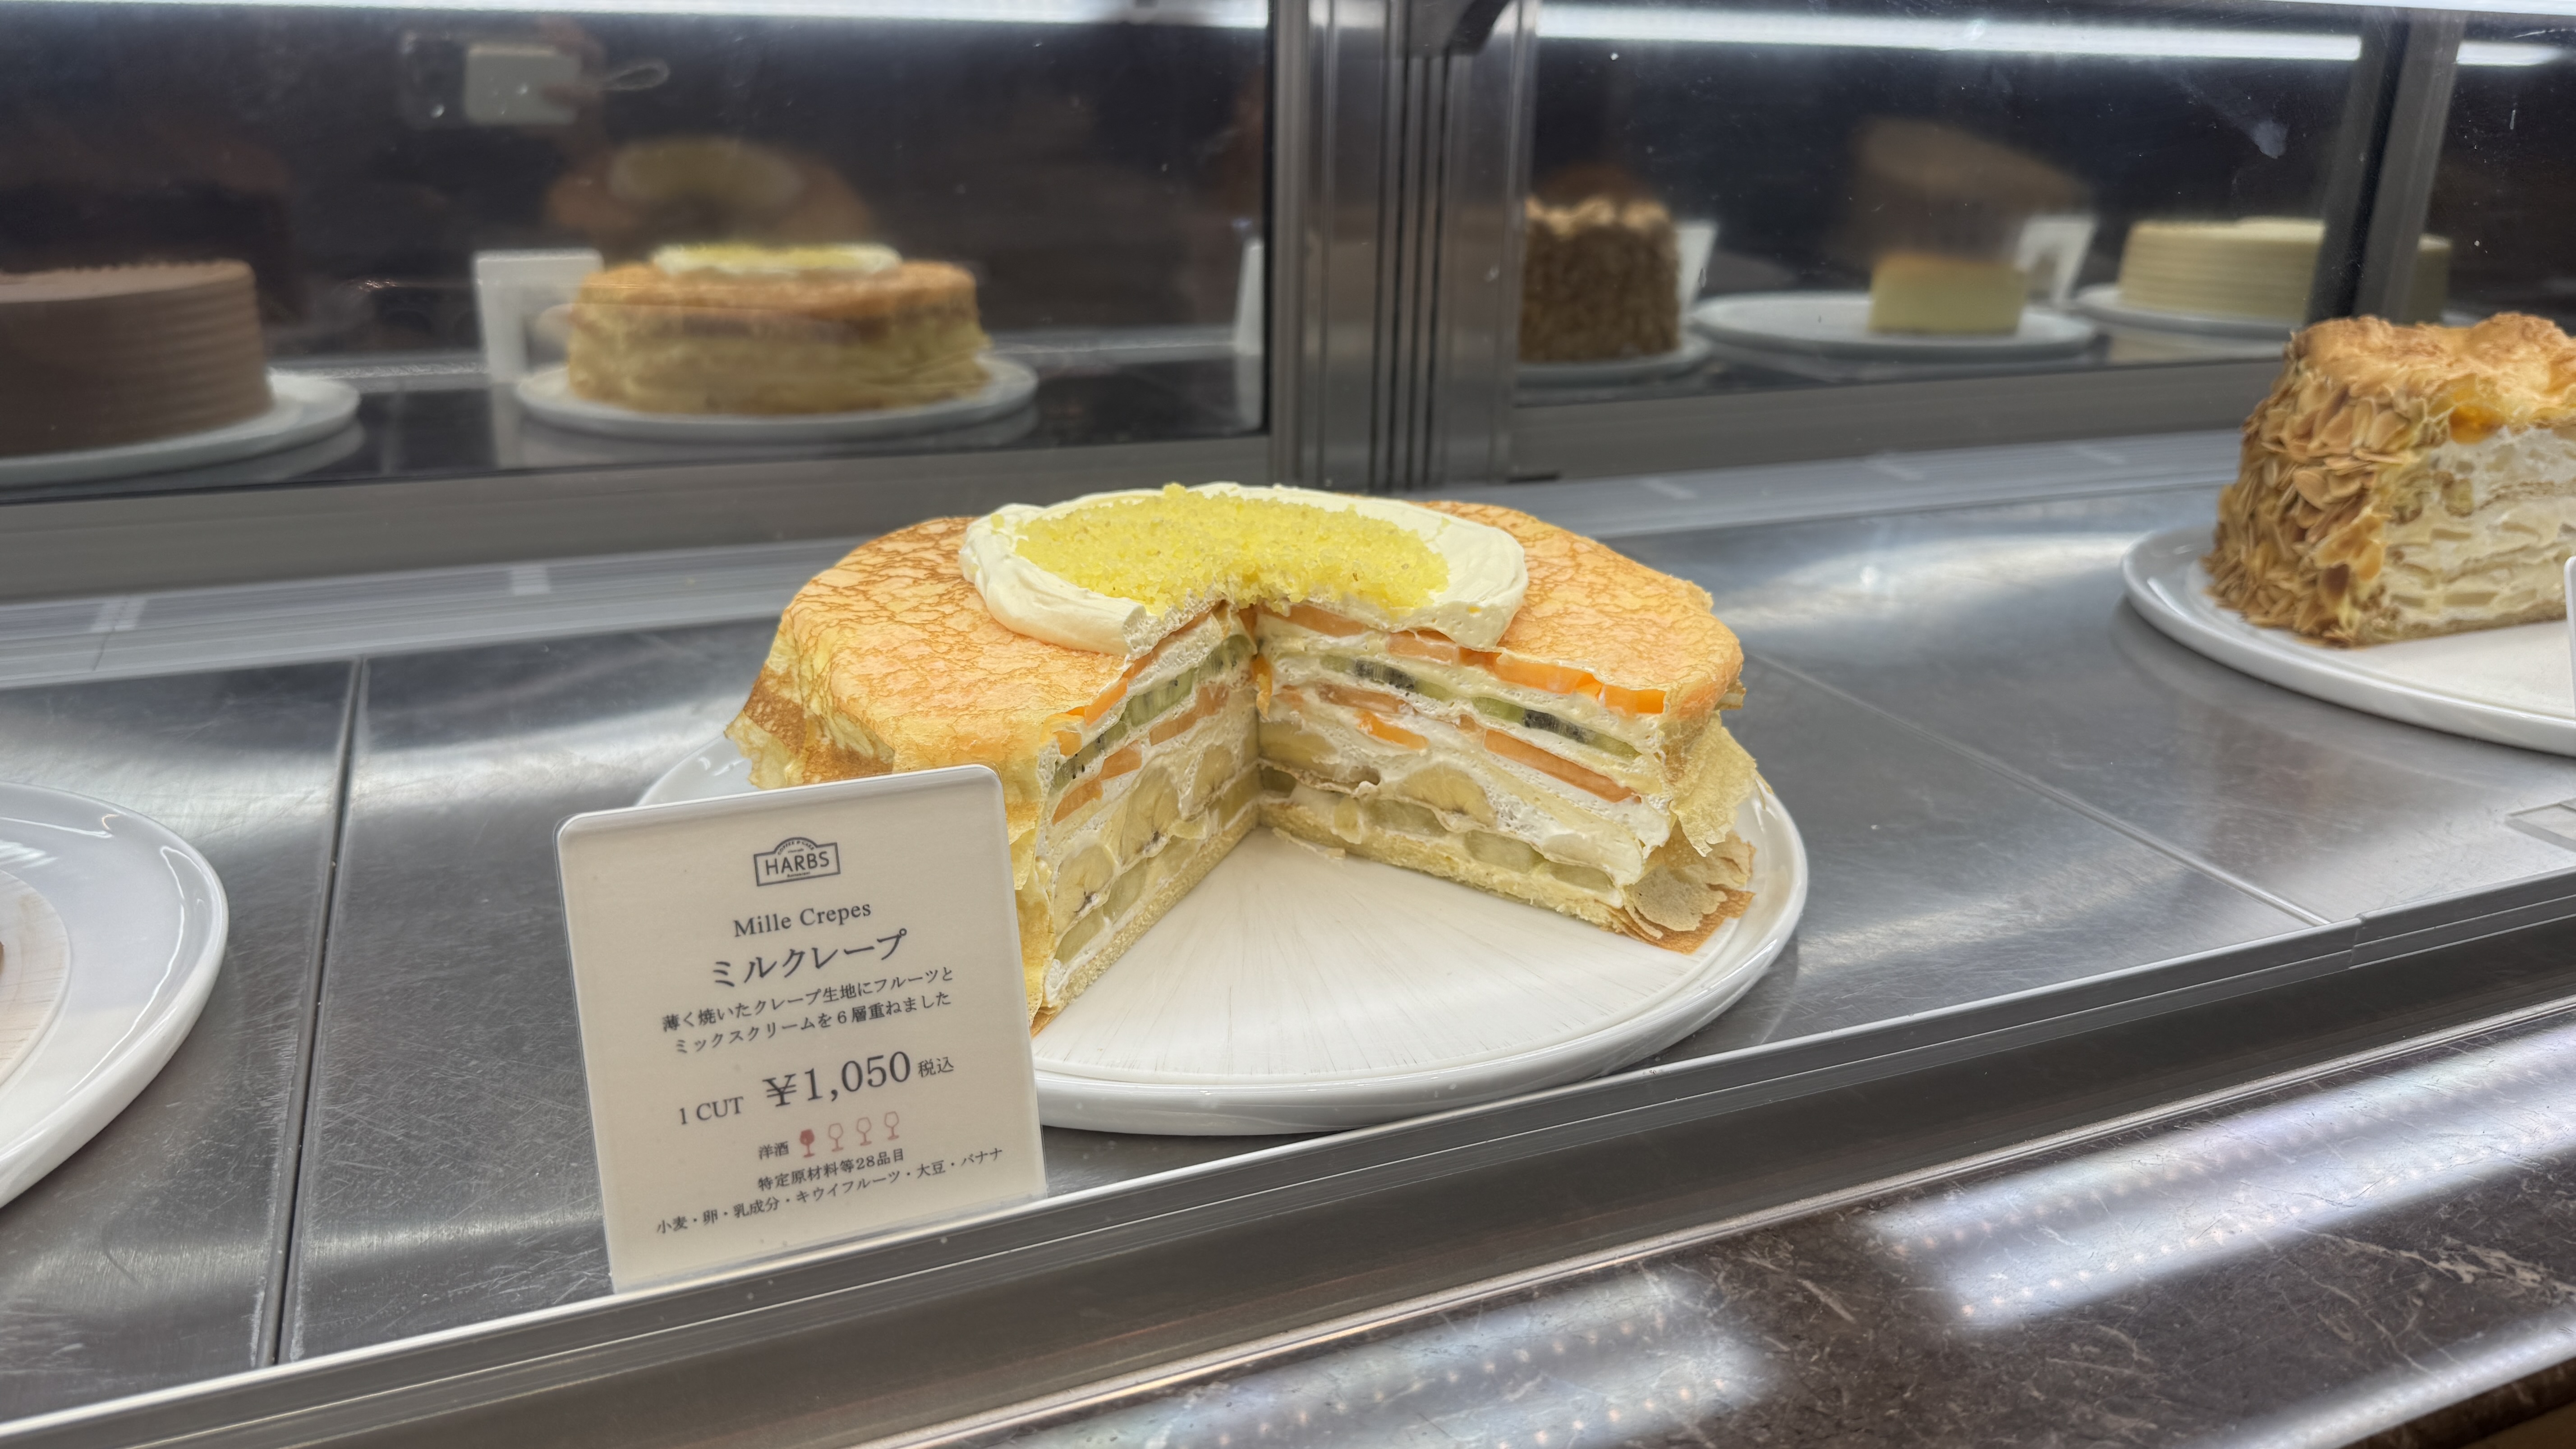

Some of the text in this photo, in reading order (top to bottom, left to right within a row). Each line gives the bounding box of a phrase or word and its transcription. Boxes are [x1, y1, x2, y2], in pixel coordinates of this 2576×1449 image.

[765, 851, 829, 875] HARBS
[732, 904, 871, 938] Mille Crepes
[712, 928, 907, 988] ミルクレープ
[662, 966, 953, 1033] 薄く焼いたクレープ生地にフルーツと
[676, 991, 952, 1054] ミックスクリームを6層重ねました
[679, 1051, 954, 1125] 1 CUT ¥1,050 税込
[757, 1148, 904, 1191] 特定原材料等28品目
[758, 1141, 789, 1160] 洋酒
